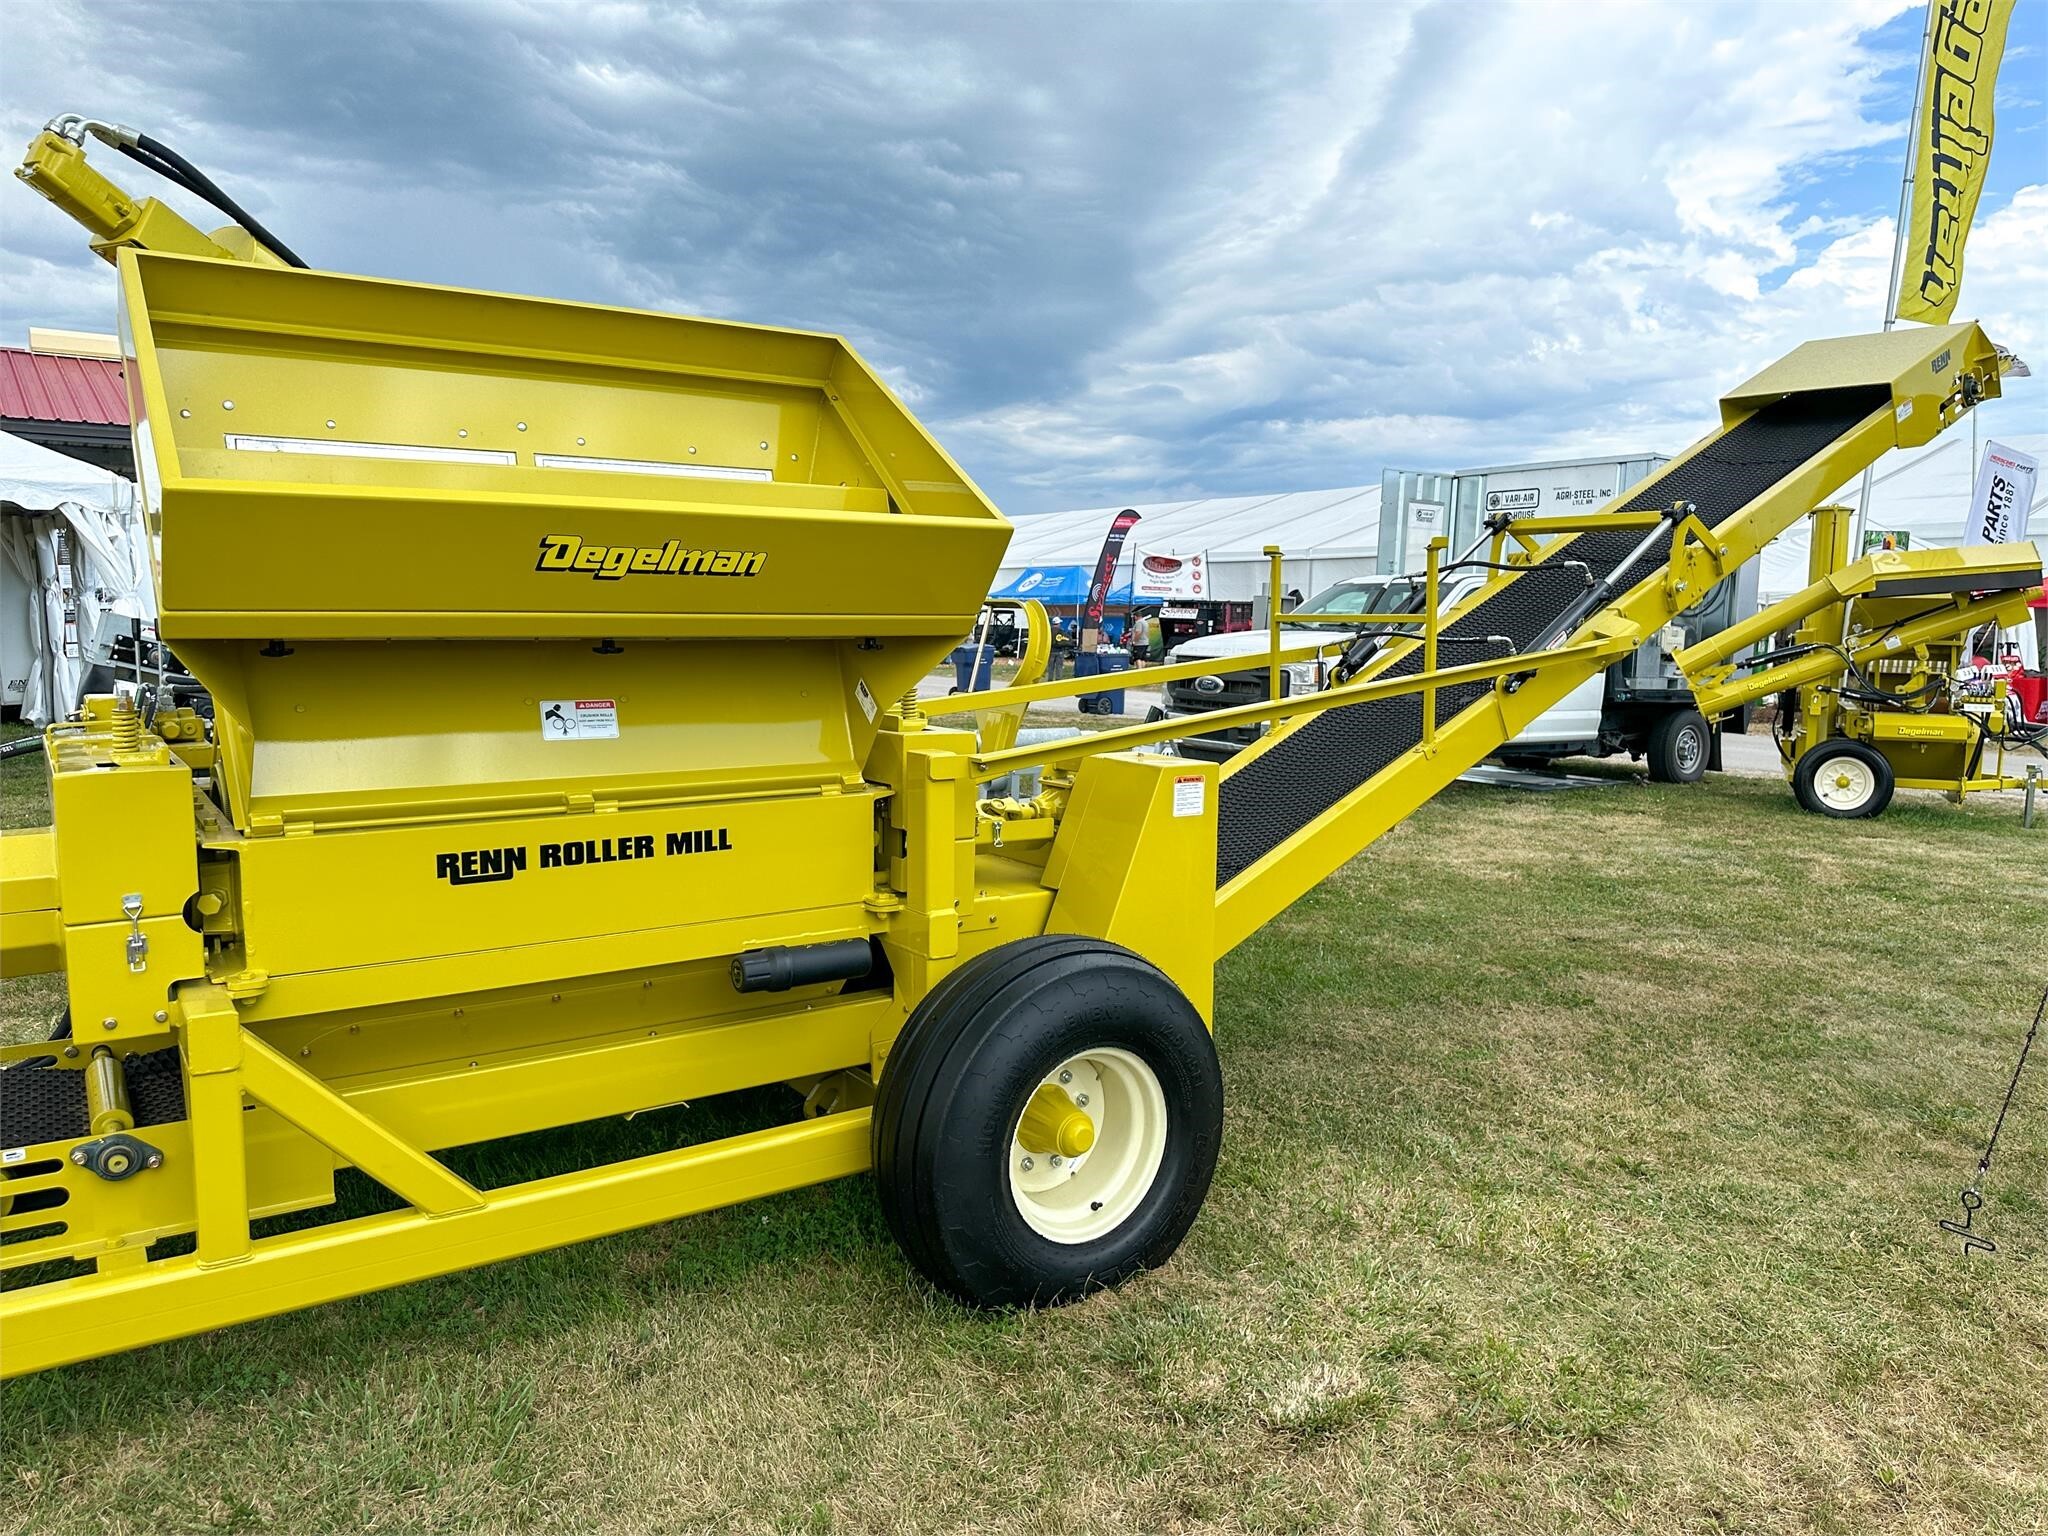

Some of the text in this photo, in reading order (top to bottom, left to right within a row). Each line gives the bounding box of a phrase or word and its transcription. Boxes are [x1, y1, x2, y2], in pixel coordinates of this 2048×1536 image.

[1920, 0, 1993, 307] egelman
[1931, 348, 1951, 374] RENN
[1505, 493, 1535, 503] VARI-AIR
[1981, 474, 2007, 544] PARTS
[2003, 481, 2016, 510] 1887
[534, 533, 769, 581] Degelman
[1747, 672, 1789, 691] Degelman
[1897, 726, 1945, 738] Degelman
[435, 828, 733, 886] RENN ROLLER MILL
